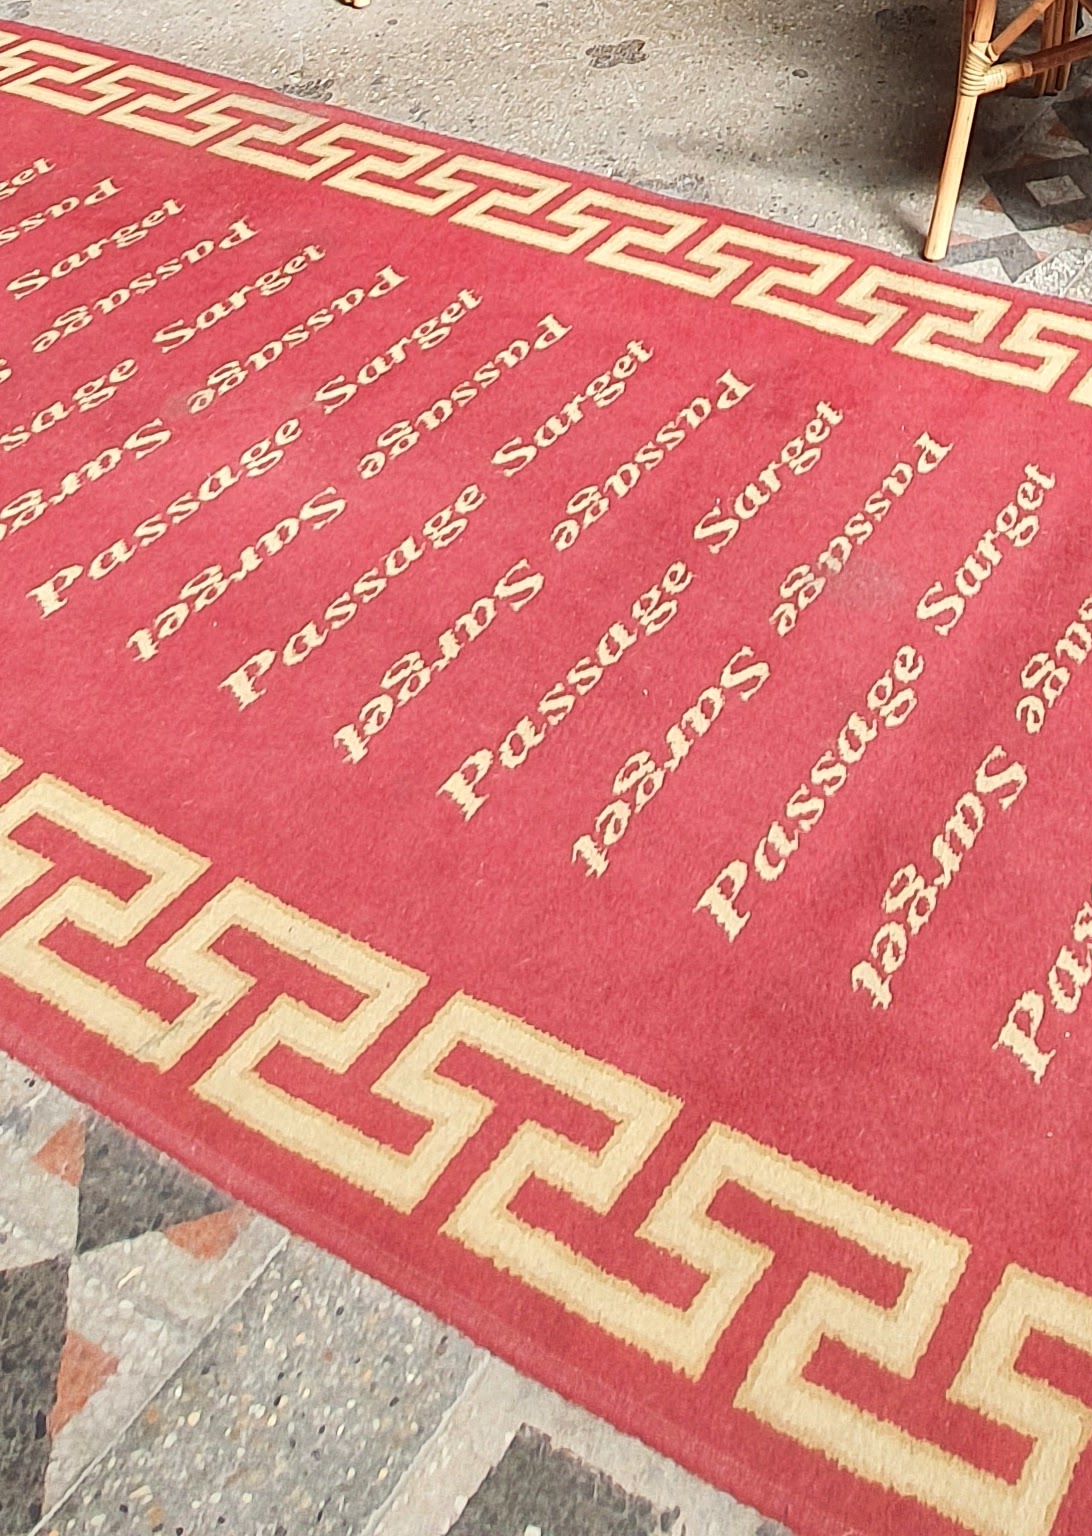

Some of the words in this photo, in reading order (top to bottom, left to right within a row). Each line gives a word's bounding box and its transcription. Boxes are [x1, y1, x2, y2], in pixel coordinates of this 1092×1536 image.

[6, 198, 185, 300] Sarget
[31, 216, 261, 354] Passage
[152, 244, 326, 353] Sarget
[188, 264, 408, 416] Passage
[0, 418, 172, 542] Sarg
[26, 418, 302, 619] Passage
[313, 286, 483, 415] Sarget
[358, 313, 572, 481] Passage
[550, 369, 753, 552] Passage
[126, 486, 348, 662] Sarget
[218, 482, 487, 712] Passage
[489, 339, 653, 479] Sarget
[437, 560, 694, 823] Passage
[691, 399, 844, 556] Sarget
[769, 431, 952, 638] Passage
[333, 557, 546, 764] Sarget
[693, 643, 925, 943] Passage
[914, 463, 1057, 638] Sarget
[570, 645, 771, 879] Sarget
[849, 745, 1029, 1011] Sarget
